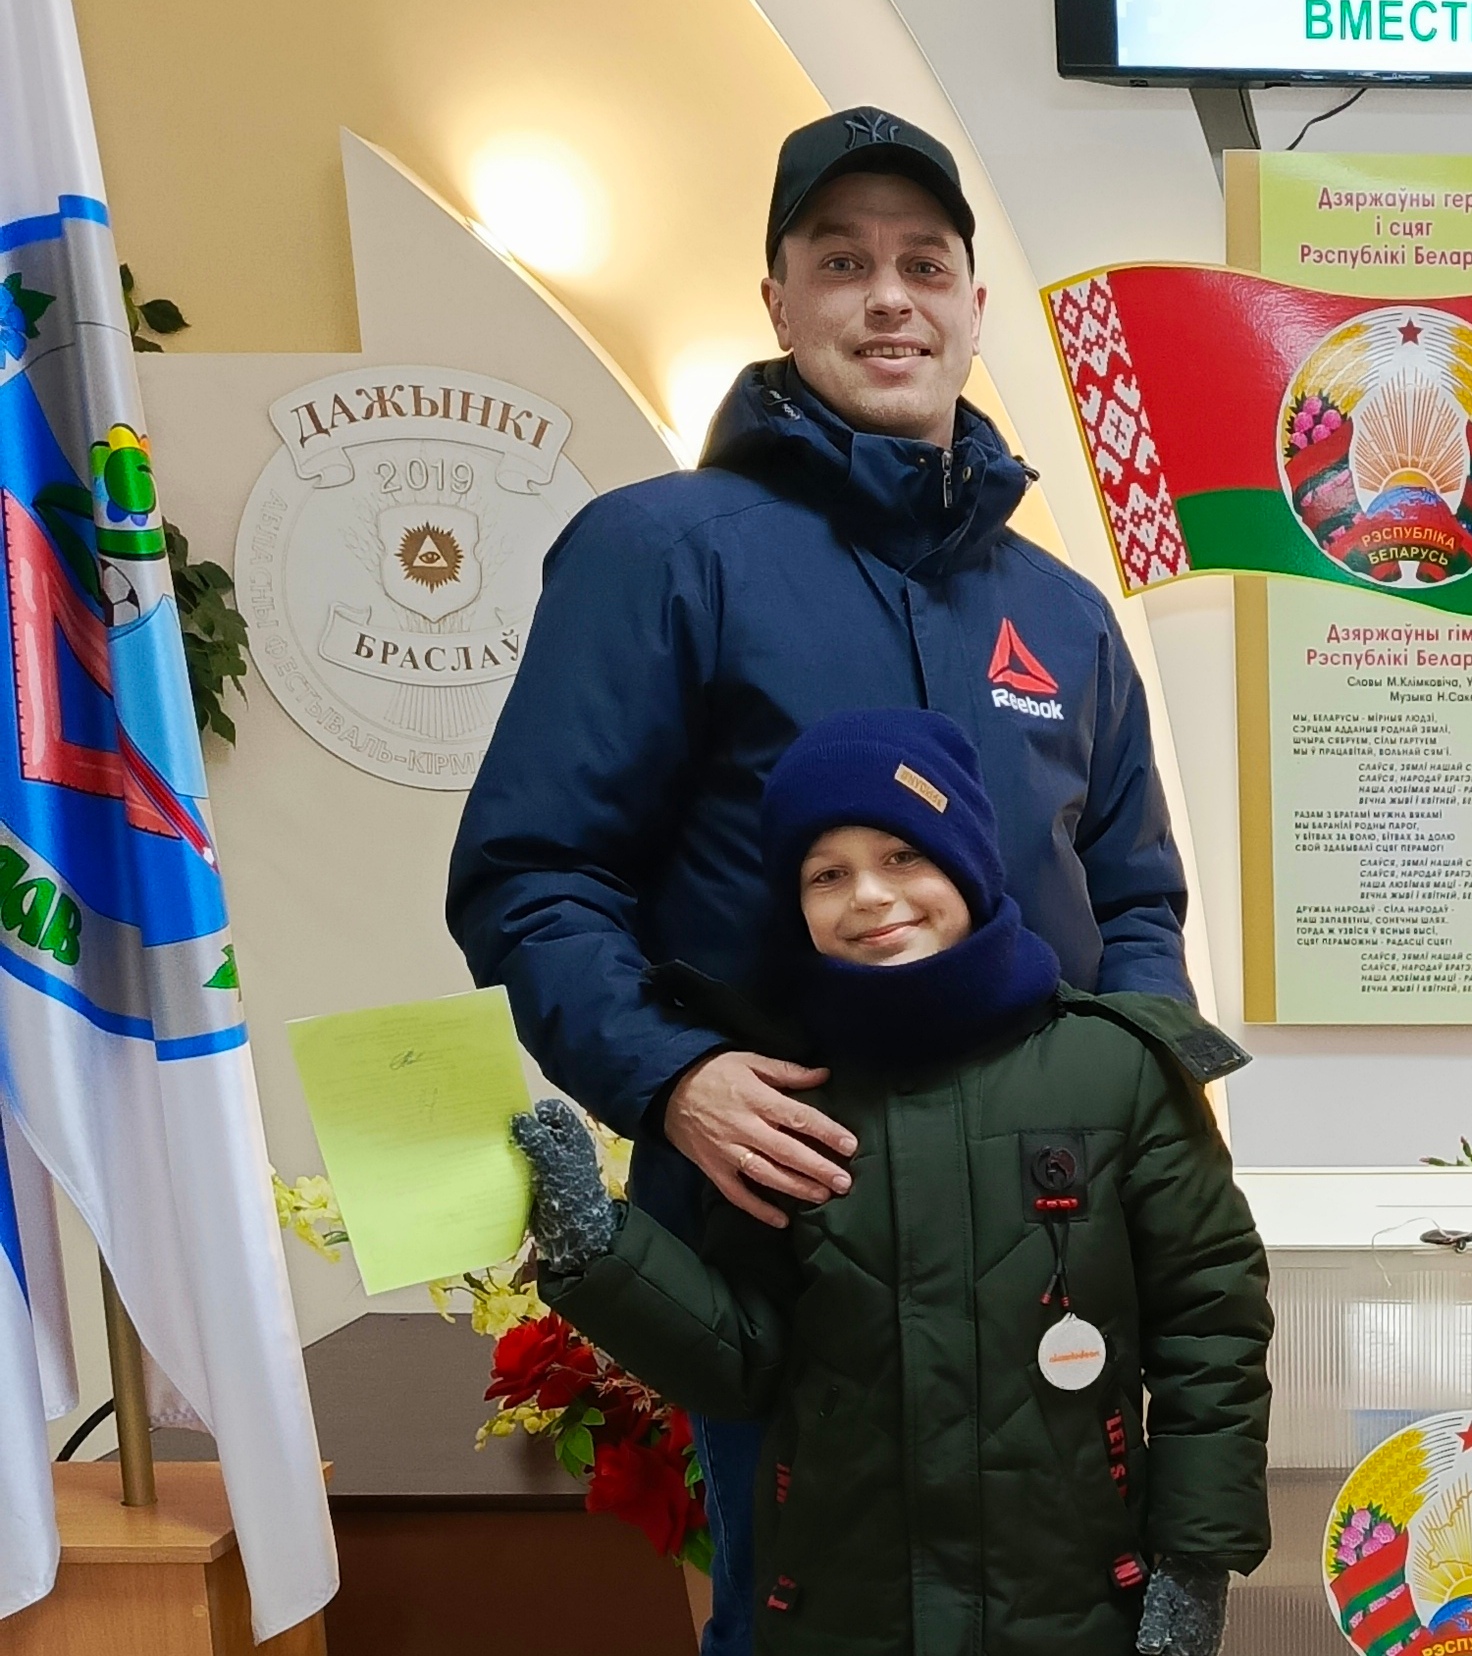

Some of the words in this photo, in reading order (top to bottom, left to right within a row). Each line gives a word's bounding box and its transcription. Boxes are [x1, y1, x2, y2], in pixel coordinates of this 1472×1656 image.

[1318, 187, 1436, 213] Дзяржаўны
[1389, 221, 1433, 239] сцяг
[1300, 244, 1406, 270] Рэспублікі
[290, 384, 554, 450] ДАЖЫНКІ
[376, 457, 475, 494] 2019
[1361, 526, 1456, 550] РЭСПУБЛІКА
[1368, 546, 1449, 566] БЕЛАРУСЬ
[1326, 623, 1440, 646] Дзяржаўны
[352, 629, 521, 672] БРАСЛАЎ
[1306, 648, 1408, 671] Рэспублікі
[1346, 676, 1383, 687] Словы
[1386, 676, 1462, 689] М.Клімковіча,
[264, 633, 488, 776] ФЕСТЫВАЛЬ-КІРМ
[991, 688, 1065, 720] Reebok
[1389, 691, 1433, 705] Музыка
